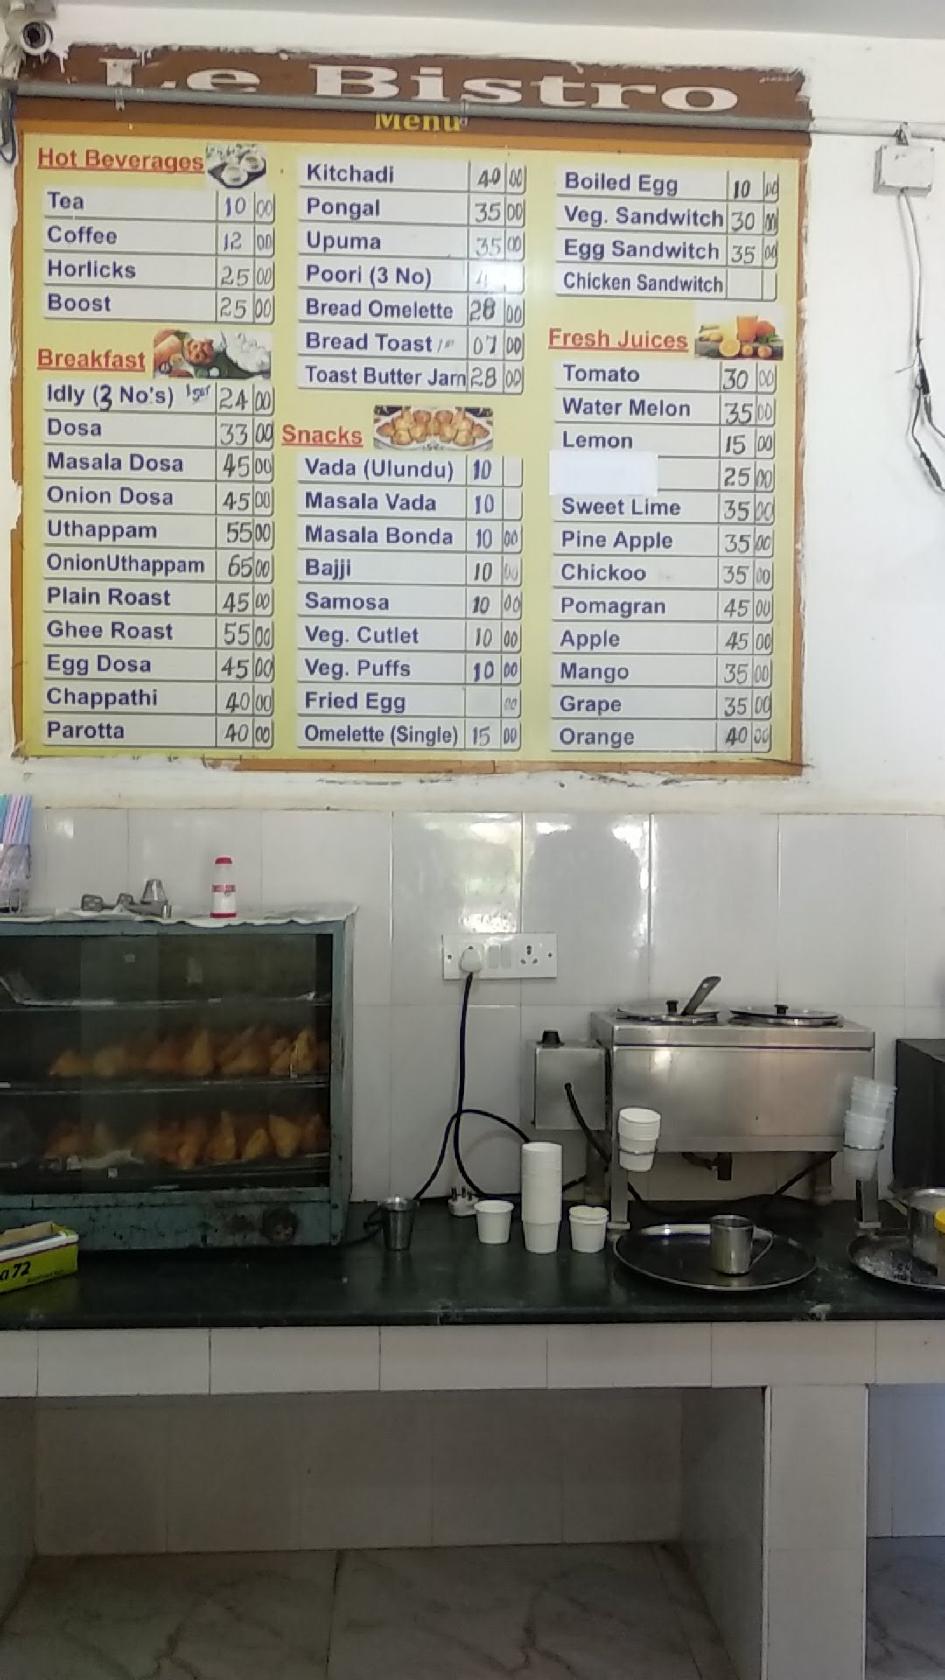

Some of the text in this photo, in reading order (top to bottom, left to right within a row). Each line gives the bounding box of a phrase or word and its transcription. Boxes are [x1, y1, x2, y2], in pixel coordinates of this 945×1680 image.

[98, 58, 738, 112] Le Bistro
[375, 113, 461, 132] Menu
[38, 147, 204, 173] Hot Beverages
[307, 164, 394, 183] Kitchadi
[478, 167, 501, 188] 40
[565, 171, 678, 196] Boiled Egg
[734, 180, 751, 199] 10
[47, 191, 84, 210] Tea
[225, 196, 246, 217] 10
[307, 197, 380, 219] Pongal
[475, 202, 500, 223] 35
[565, 205, 723, 227] Veg. Sandwitch
[731, 211, 755, 231] 30
[47, 225, 117, 244] Coffee
[223, 231, 242, 251] 12
[307, 230, 381, 253] Upuma
[565, 238, 719, 260] Egg Sandwitch
[731, 245, 755, 264] 35
[48, 259, 136, 279] Horlicks
[220, 266, 250, 286] 25
[306, 264, 432, 290] Poori (3 No)
[564, 271, 723, 293] Chicken Sandwitch
[48, 293, 111, 312] Boost
[220, 297, 247, 318] 25
[306, 298, 453, 319] Bread Omelette
[306, 332, 368, 350] Bread
[375, 333, 432, 352] Toast
[549, 328, 688, 349] Fresh Juices
[38, 348, 145, 369] Breakfast
[305, 365, 466, 386] Toast Butter Jam
[471, 367, 497, 388] 28
[563, 364, 639, 382] Tomato
[723, 368, 748, 390] 30
[47, 384, 85, 406] Idly
[120, 386, 174, 409] No's)
[219, 387, 248, 410] 24
[563, 397, 691, 417] Water Melon
[724, 402, 752, 425] 35
[47, 418, 102, 436] Dosa
[220, 423, 248, 446] 33
[282, 424, 363, 444] Snacks
[563, 430, 633, 449] Lemon
[725, 434, 746, 455] 15
[47, 452, 184, 472] Masala Dosa
[223, 453, 249, 478] 45
[305, 458, 454, 480] Vada (Ulundu)
[473, 459, 492, 480] 10
[724, 467, 751, 486] 25
[47, 485, 173, 505] Onion Dosa
[222, 491, 249, 511] 45
[305, 491, 436, 511] Masala Vada
[475, 494, 494, 514] 10
[562, 497, 681, 515] Sweet Lime
[724, 500, 750, 521] 35
[48, 519, 157, 541] Uthappam
[226, 522, 252, 543] 55
[305, 525, 453, 545] Masala Bonda
[476, 528, 493, 549] 10
[562, 530, 673, 552] Pine Apple
[725, 534, 751, 553] 35
[47, 553, 205, 577] OnionUthappam
[228, 554, 253, 578] 65
[305, 558, 351, 580] Bajji
[474, 562, 493, 582] 10
[562, 563, 646, 581] Chickoo
[723, 566, 749, 584] 35
[47, 586, 171, 606] Plain Roast
[222, 592, 249, 612] 45
[305, 591, 389, 610] Samosa
[472, 595, 490, 614] 10
[562, 597, 666, 619] Pomagran
[724, 599, 749, 618] 45
[47, 620, 173, 640] Ghee Roast
[224, 622, 249, 645] 55
[305, 625, 419, 647] Veg. Cutlet
[475, 628, 492, 648] 10
[560, 630, 620, 650] Apple
[725, 631, 749, 650] 45
[47, 654, 151, 676] Egg Dosa
[221, 656, 248, 679] 45
[305, 658, 411, 680] Veg. Puffs
[474, 660, 494, 682] 10
[560, 662, 629, 683] Mango
[724, 663, 748, 683] 35
[47, 687, 157, 709] Chappathi
[225, 692, 249, 712] 40
[305, 691, 405, 713] Fried Egg
[560, 695, 621, 715] Grape
[724, 697, 747, 717] 35
[47, 721, 124, 739] Parotta
[224, 723, 248, 743] 40
[305, 724, 458, 747] Omelette (Single)
[473, 726, 491, 746] 15
[559, 728, 635, 748] Orange
[725, 727, 747, 746] 40
[13, 1261, 31, 1278] 72
